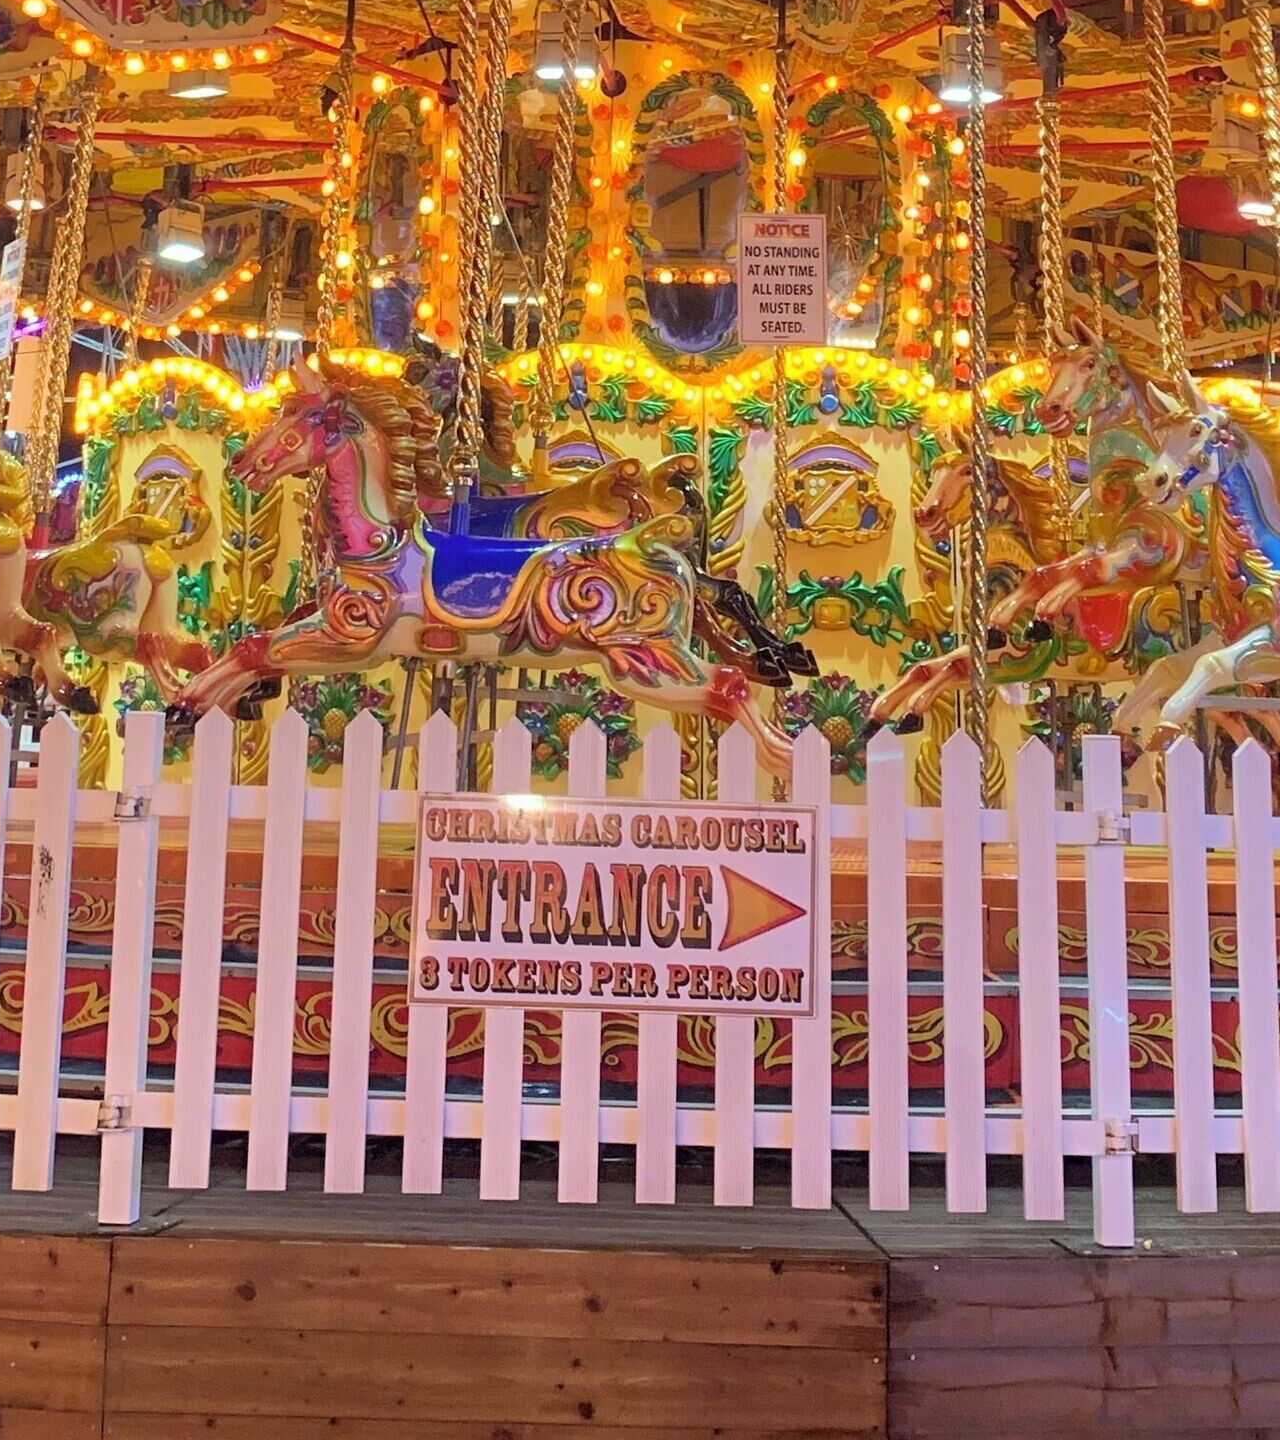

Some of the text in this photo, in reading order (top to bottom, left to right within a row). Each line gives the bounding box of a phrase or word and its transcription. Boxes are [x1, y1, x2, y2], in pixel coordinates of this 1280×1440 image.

[754, 224, 810, 237] NOTICE
[745, 246, 820, 258] NO STANDING
[748, 265, 818, 277] AT ANY TIME.
[752, 284, 813, 296] ALL RIDERS
[759, 303, 806, 314] MUST BE
[762, 321, 805, 333] SEATED.
[426, 806, 806, 854] CHRISTMAS CAROUSEL
[425, 856, 713, 950] ENTRANCE
[447, 957, 582, 996] TOKENS
[589, 960, 659, 999] PER
[665, 962, 805, 1004] PERSON
